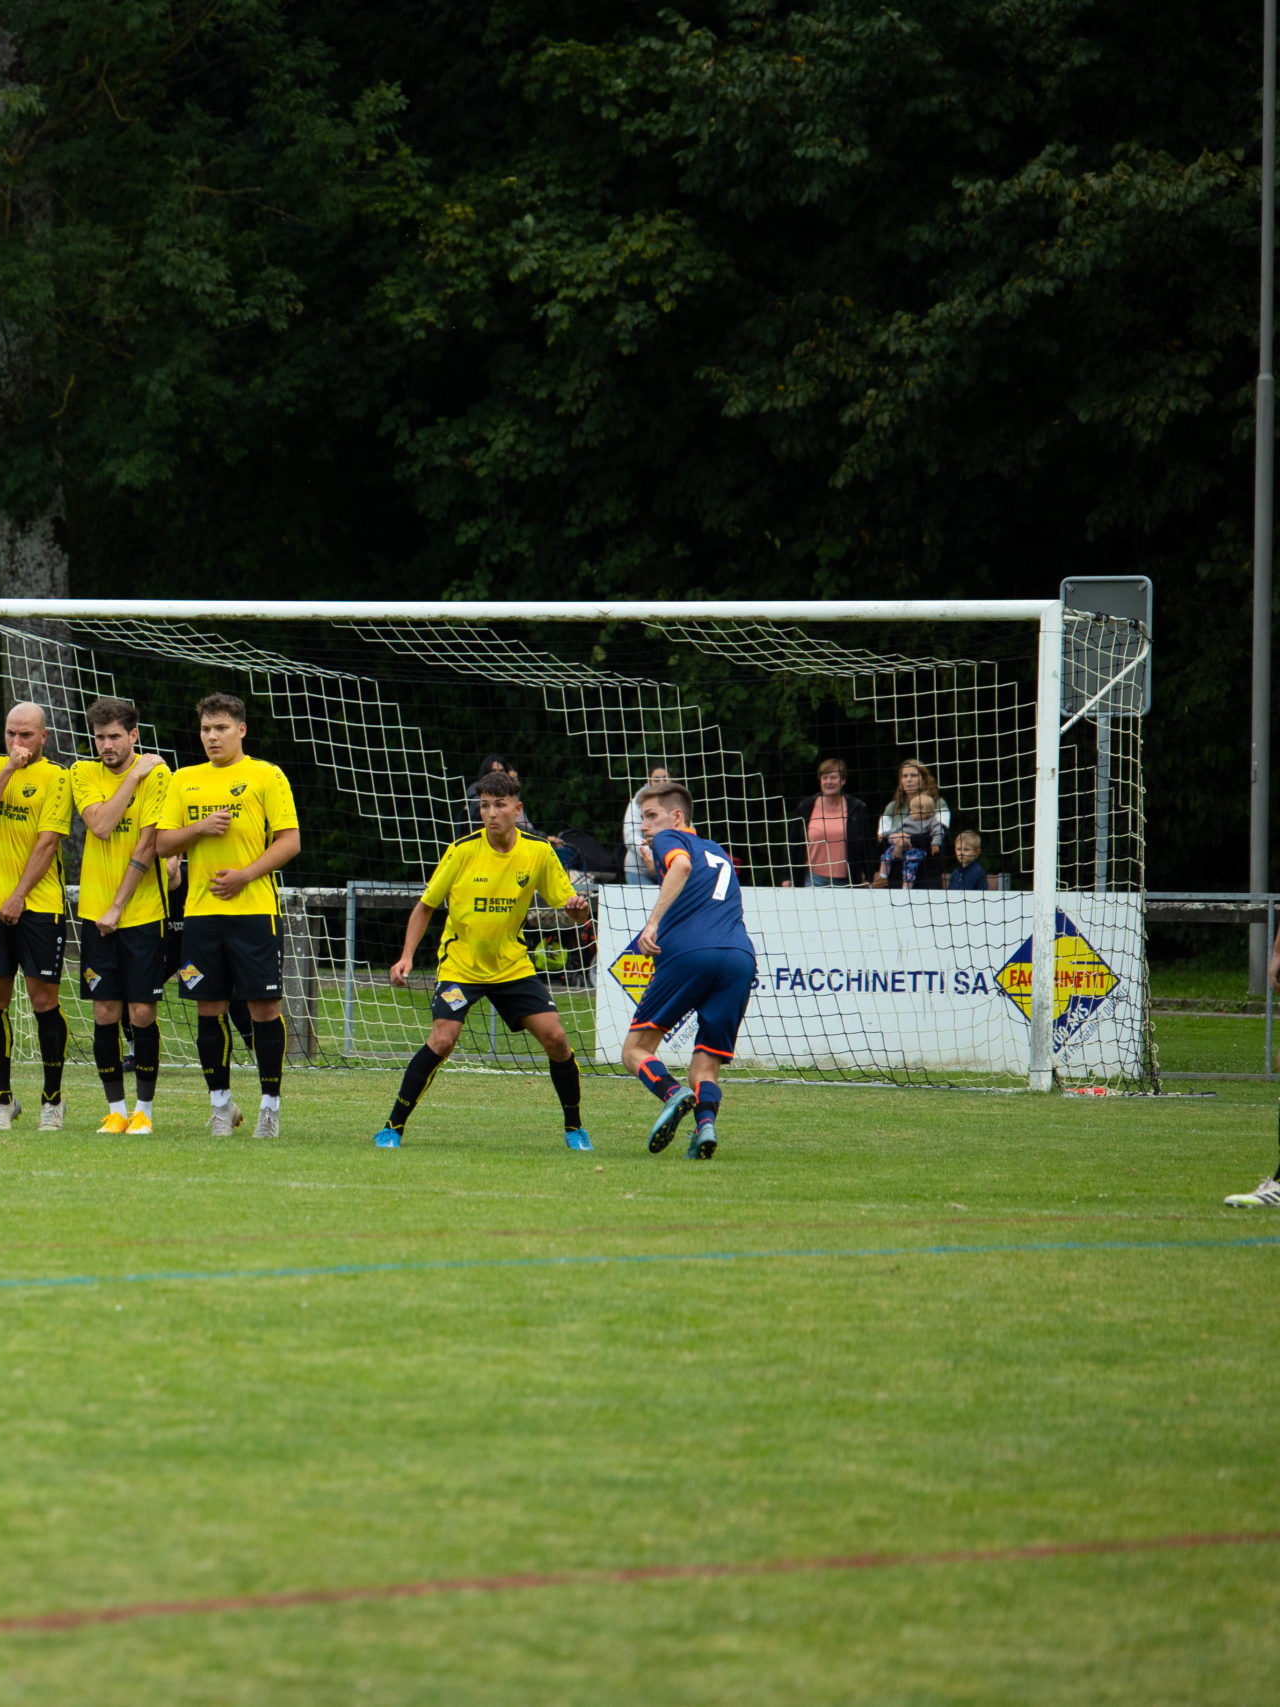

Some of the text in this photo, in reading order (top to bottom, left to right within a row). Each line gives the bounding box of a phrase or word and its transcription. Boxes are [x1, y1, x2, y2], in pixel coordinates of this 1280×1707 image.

[704, 850, 732, 901] 7
[488, 905, 513, 913] DENT
[489, 897, 517, 905] SETIM
[776, 967, 945, 994] FACCHINETTI
[954, 971, 989, 995] SA
[1010, 969, 1104, 989] FACINETTI
